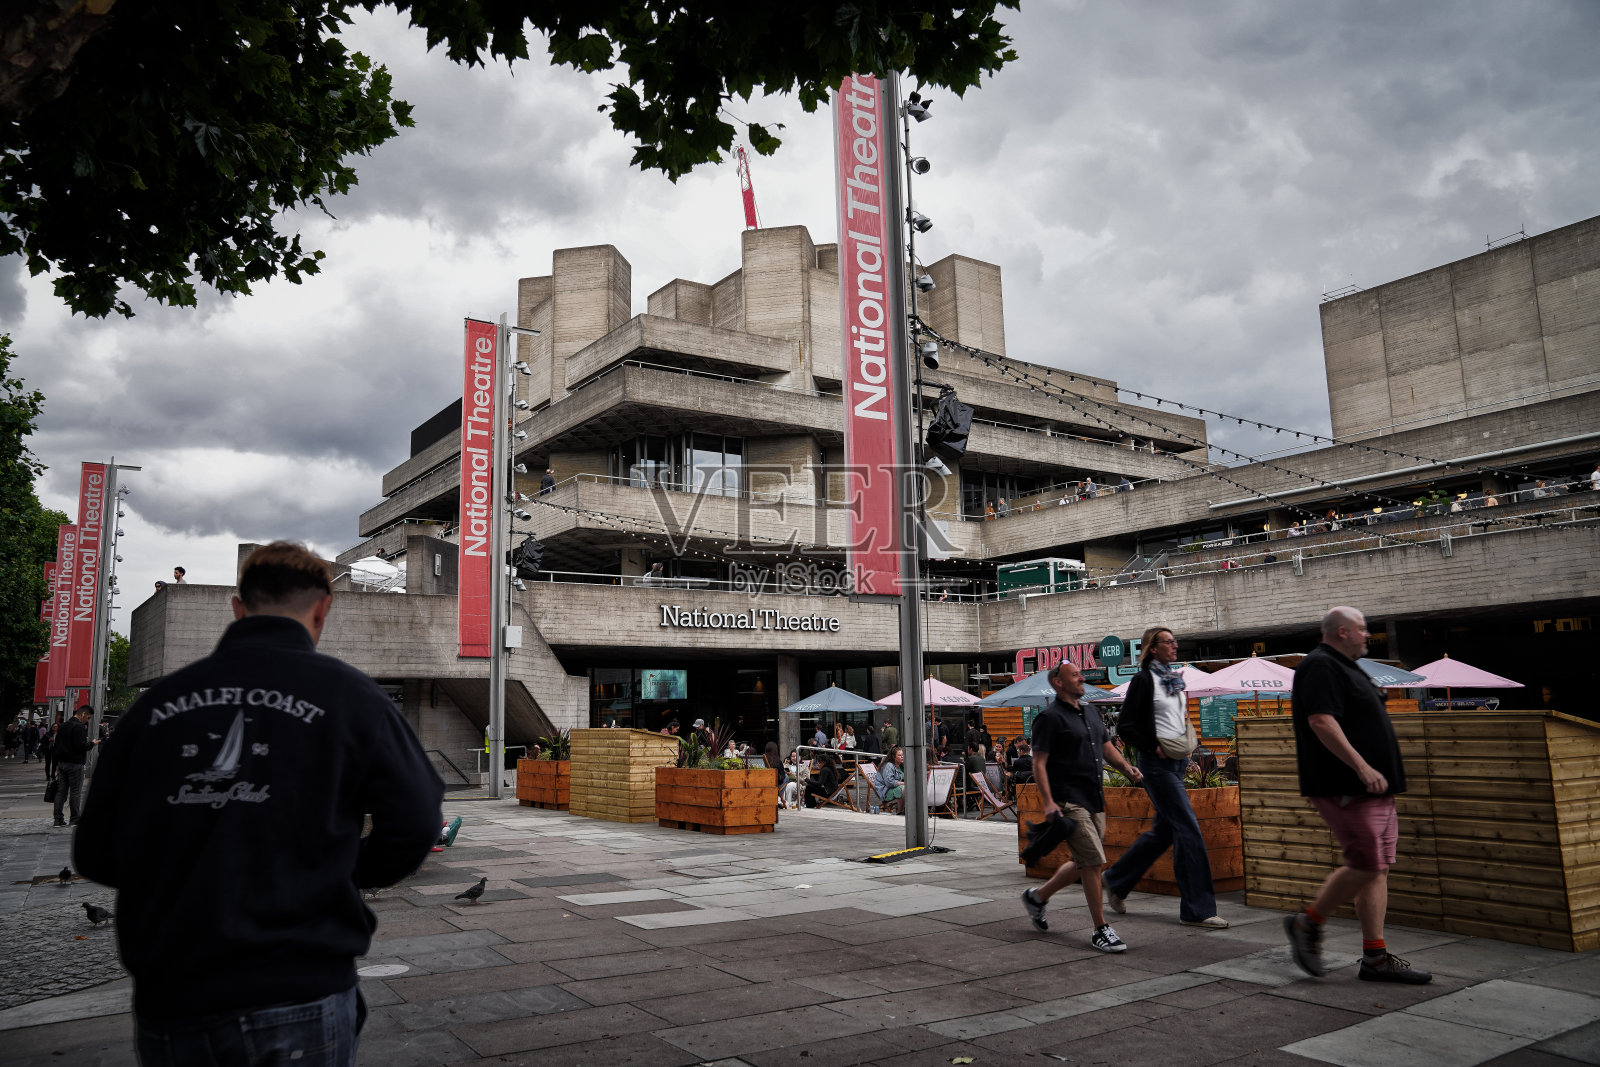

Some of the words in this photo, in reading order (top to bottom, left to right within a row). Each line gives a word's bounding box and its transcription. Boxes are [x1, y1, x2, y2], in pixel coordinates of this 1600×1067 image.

[846, 71, 880, 219] Theatr
[848, 229, 888, 421] National
[467, 336, 492, 440] Theatre
[79, 473, 102, 544] Theatre
[465, 447, 489, 557] National
[58, 532, 75, 588] Theatre
[74, 549, 97, 622] National
[53, 590, 71, 647] National
[660, 605, 757, 629] National
[759, 609, 841, 632] Theatre
[1037, 644, 1097, 670] DRINK
[1102, 645, 1120, 657] KERB
[149, 687, 244, 726] AMALFI
[246, 688, 326, 724] COAST
[1240, 679, 1284, 688] KERB
[227, 781, 271, 803] Club
